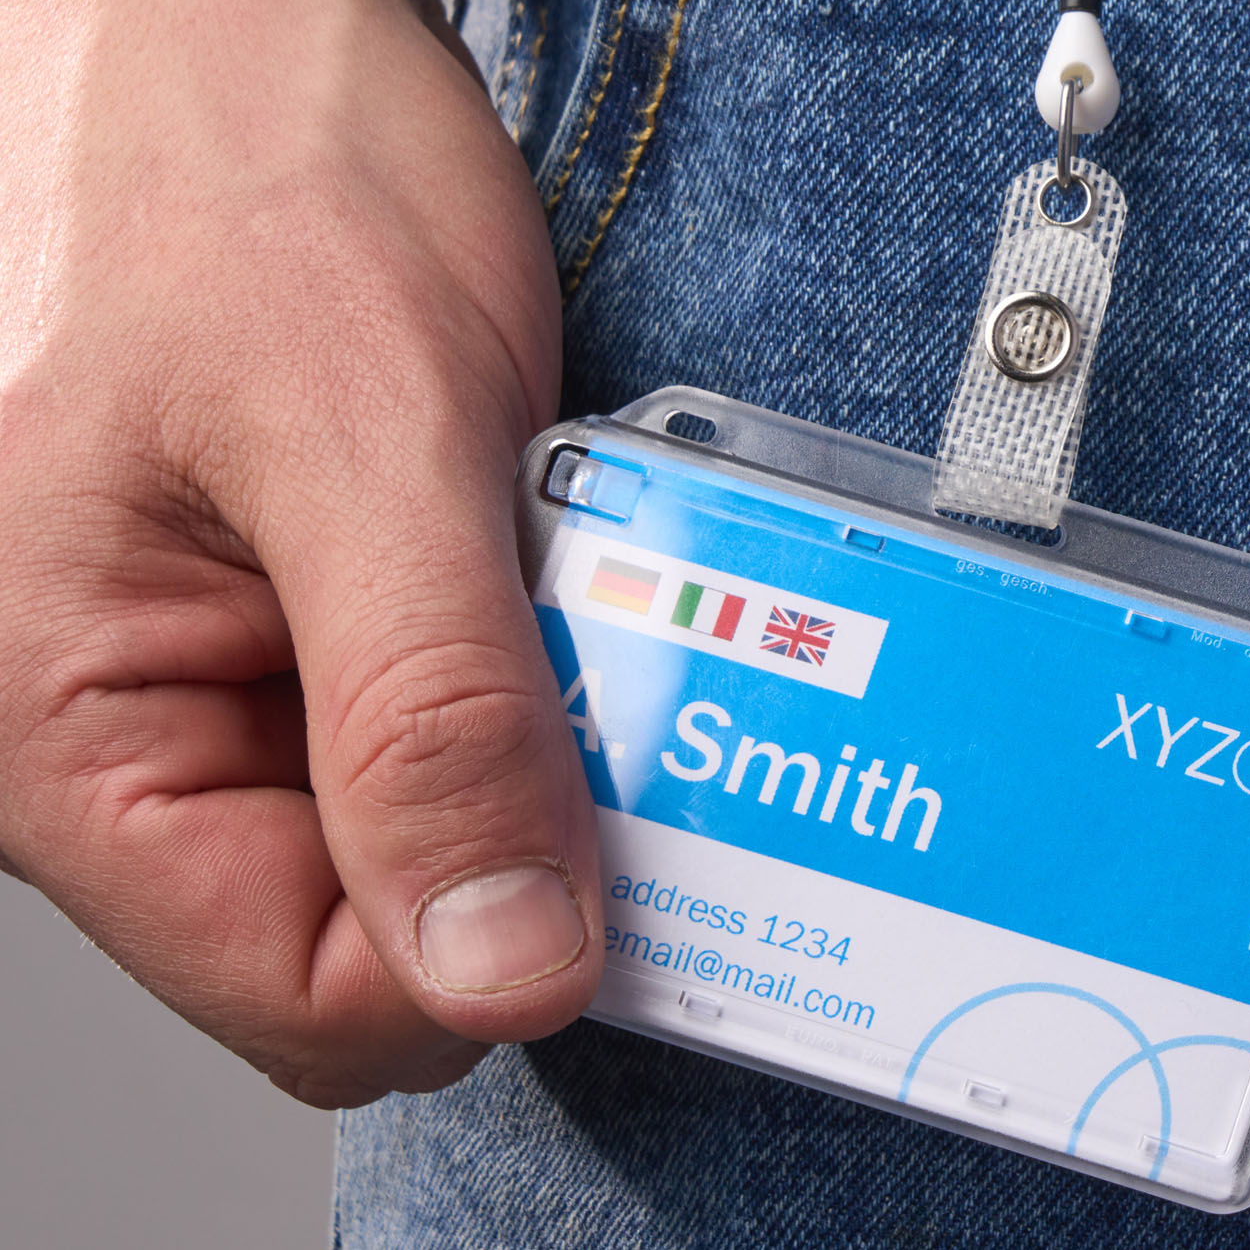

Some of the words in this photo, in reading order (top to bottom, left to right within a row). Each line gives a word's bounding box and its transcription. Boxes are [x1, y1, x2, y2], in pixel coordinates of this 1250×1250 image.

[955, 559, 989, 579] ges.
[1000, 573, 1053, 598] gesch.
[1191, 630, 1226, 651] Mod.
[562, 667, 626, 759] A.
[661, 701, 942, 852] Smith
[611, 875, 747, 935] address
[757, 915, 851, 966] 1234
[605, 926, 875, 1029] email@mail.com
